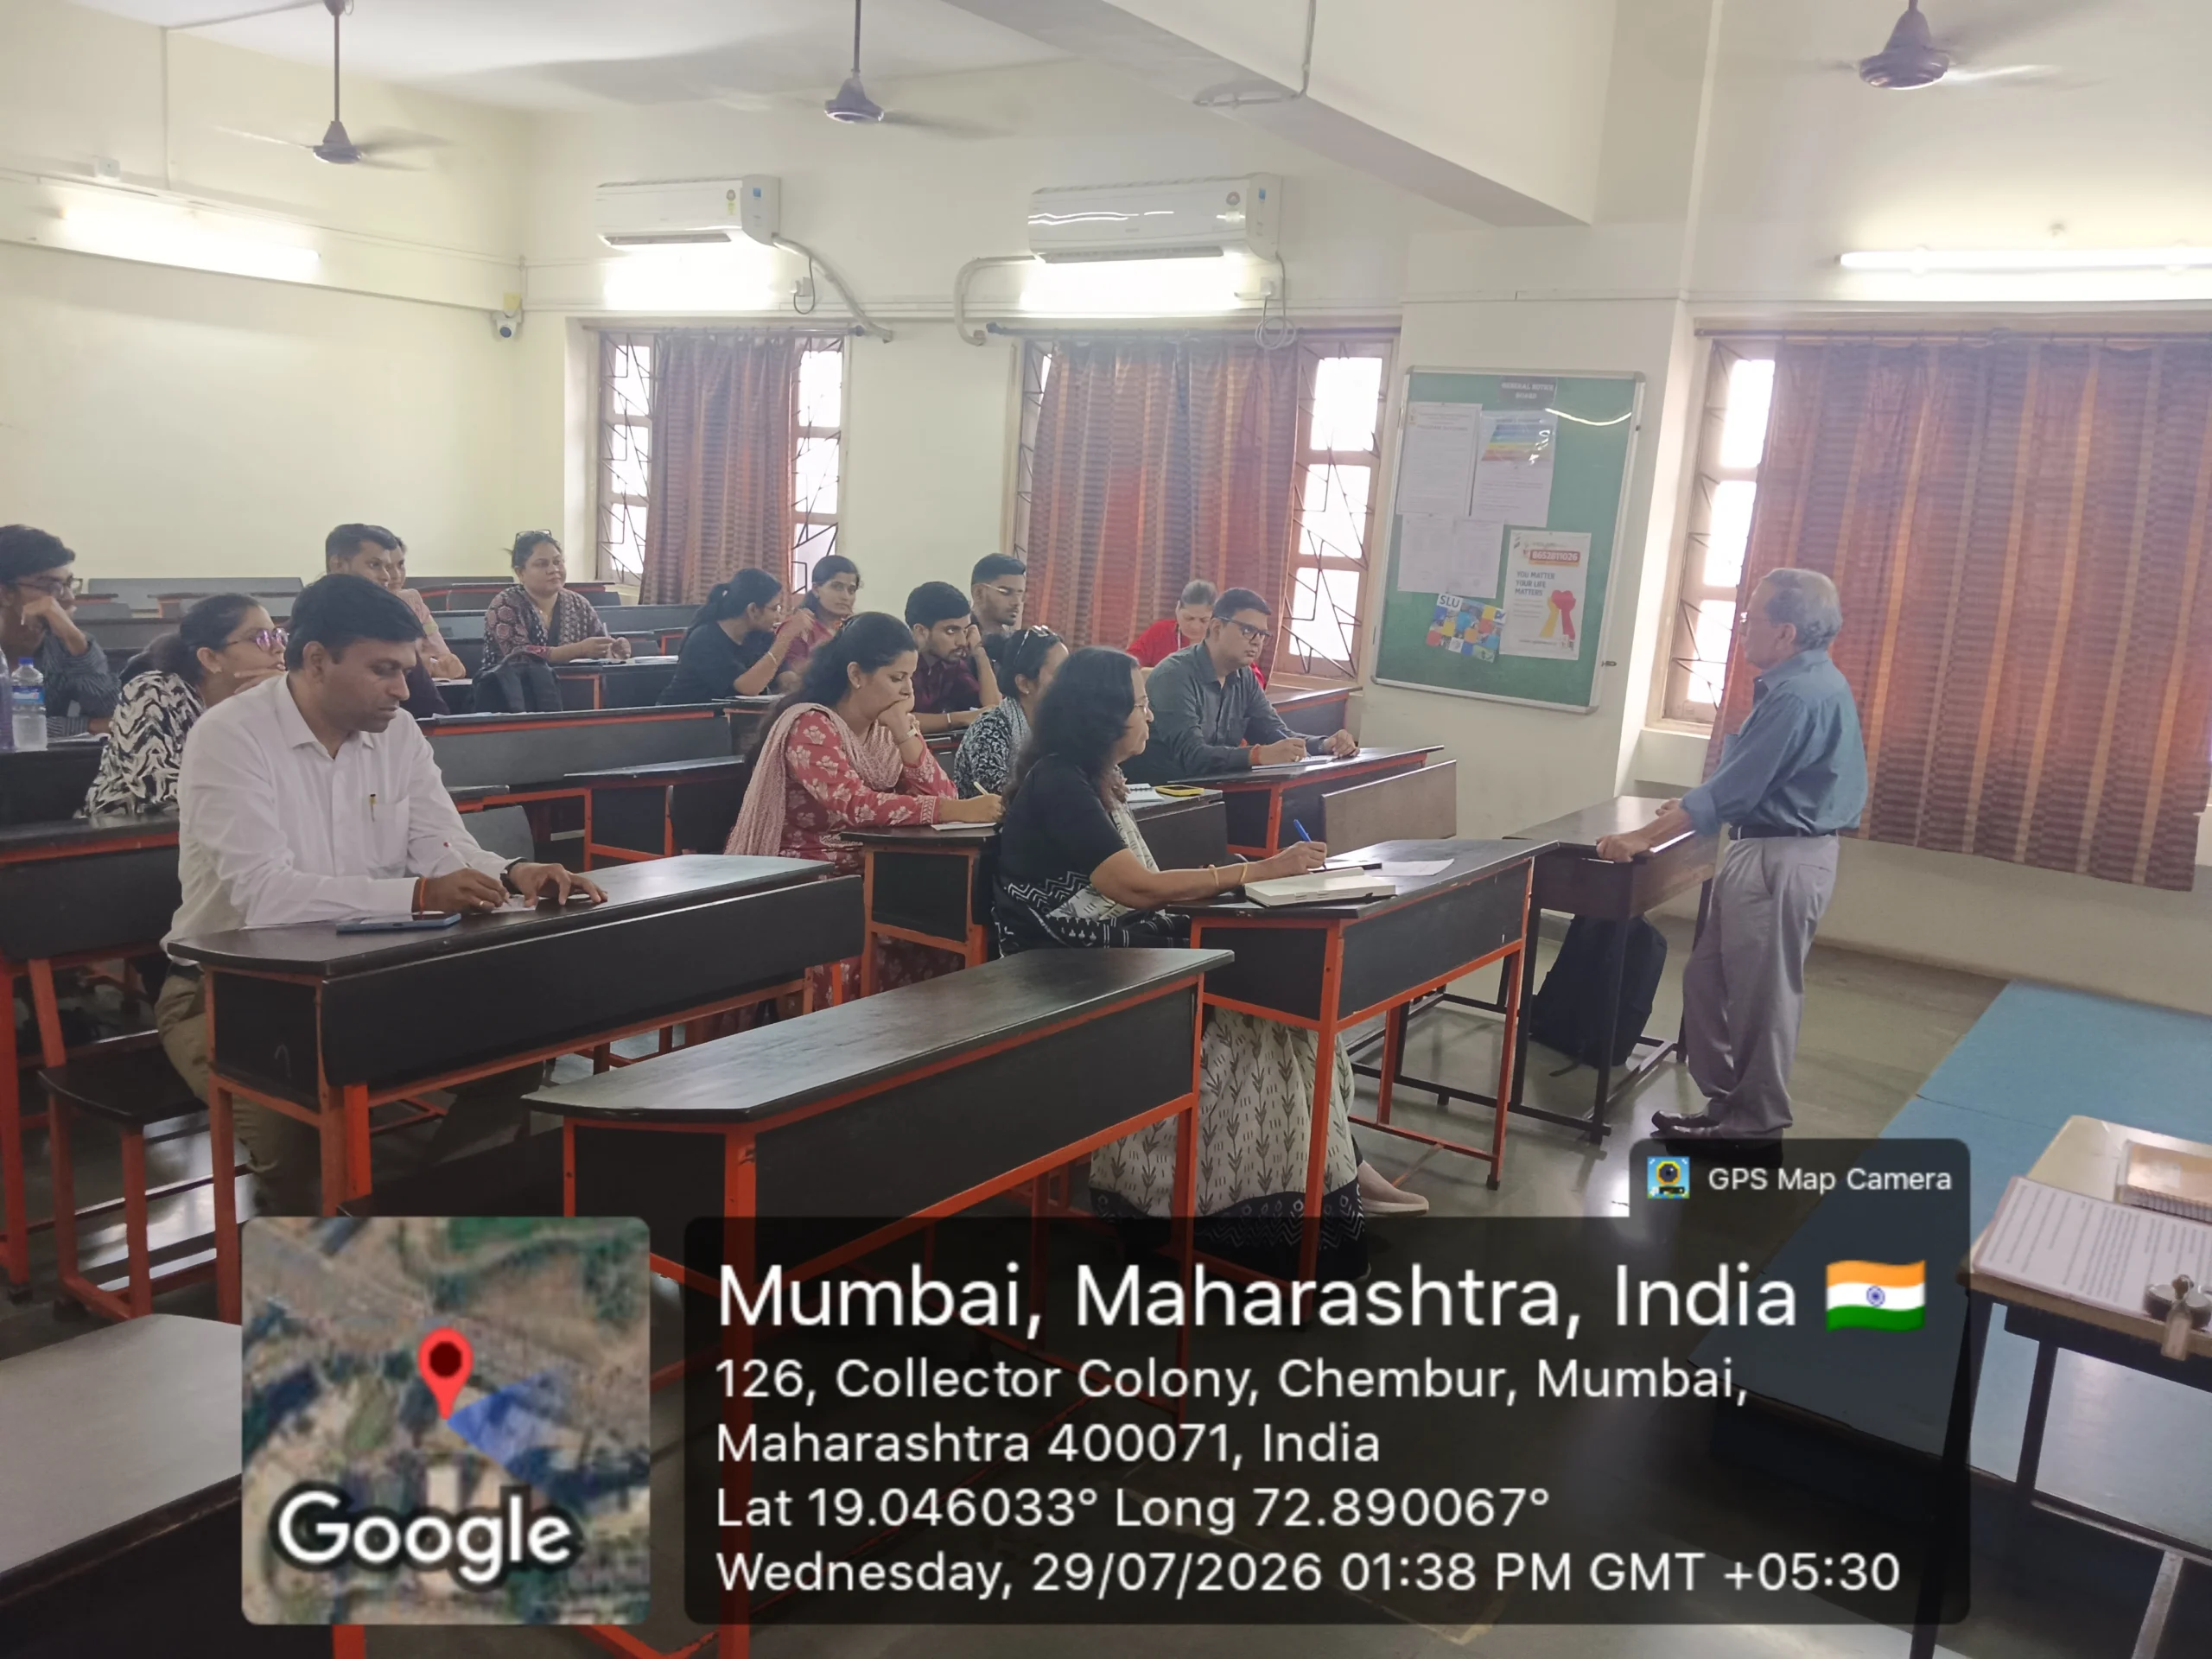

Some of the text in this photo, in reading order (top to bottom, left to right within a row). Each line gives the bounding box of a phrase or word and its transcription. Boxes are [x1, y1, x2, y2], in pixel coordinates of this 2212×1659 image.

[1530, 571, 1555, 580] MATTER
[1516, 579, 1533, 588] YOUR
[1515, 588, 1543, 597] MATTERS
[1439, 595, 1460, 608] SLU
